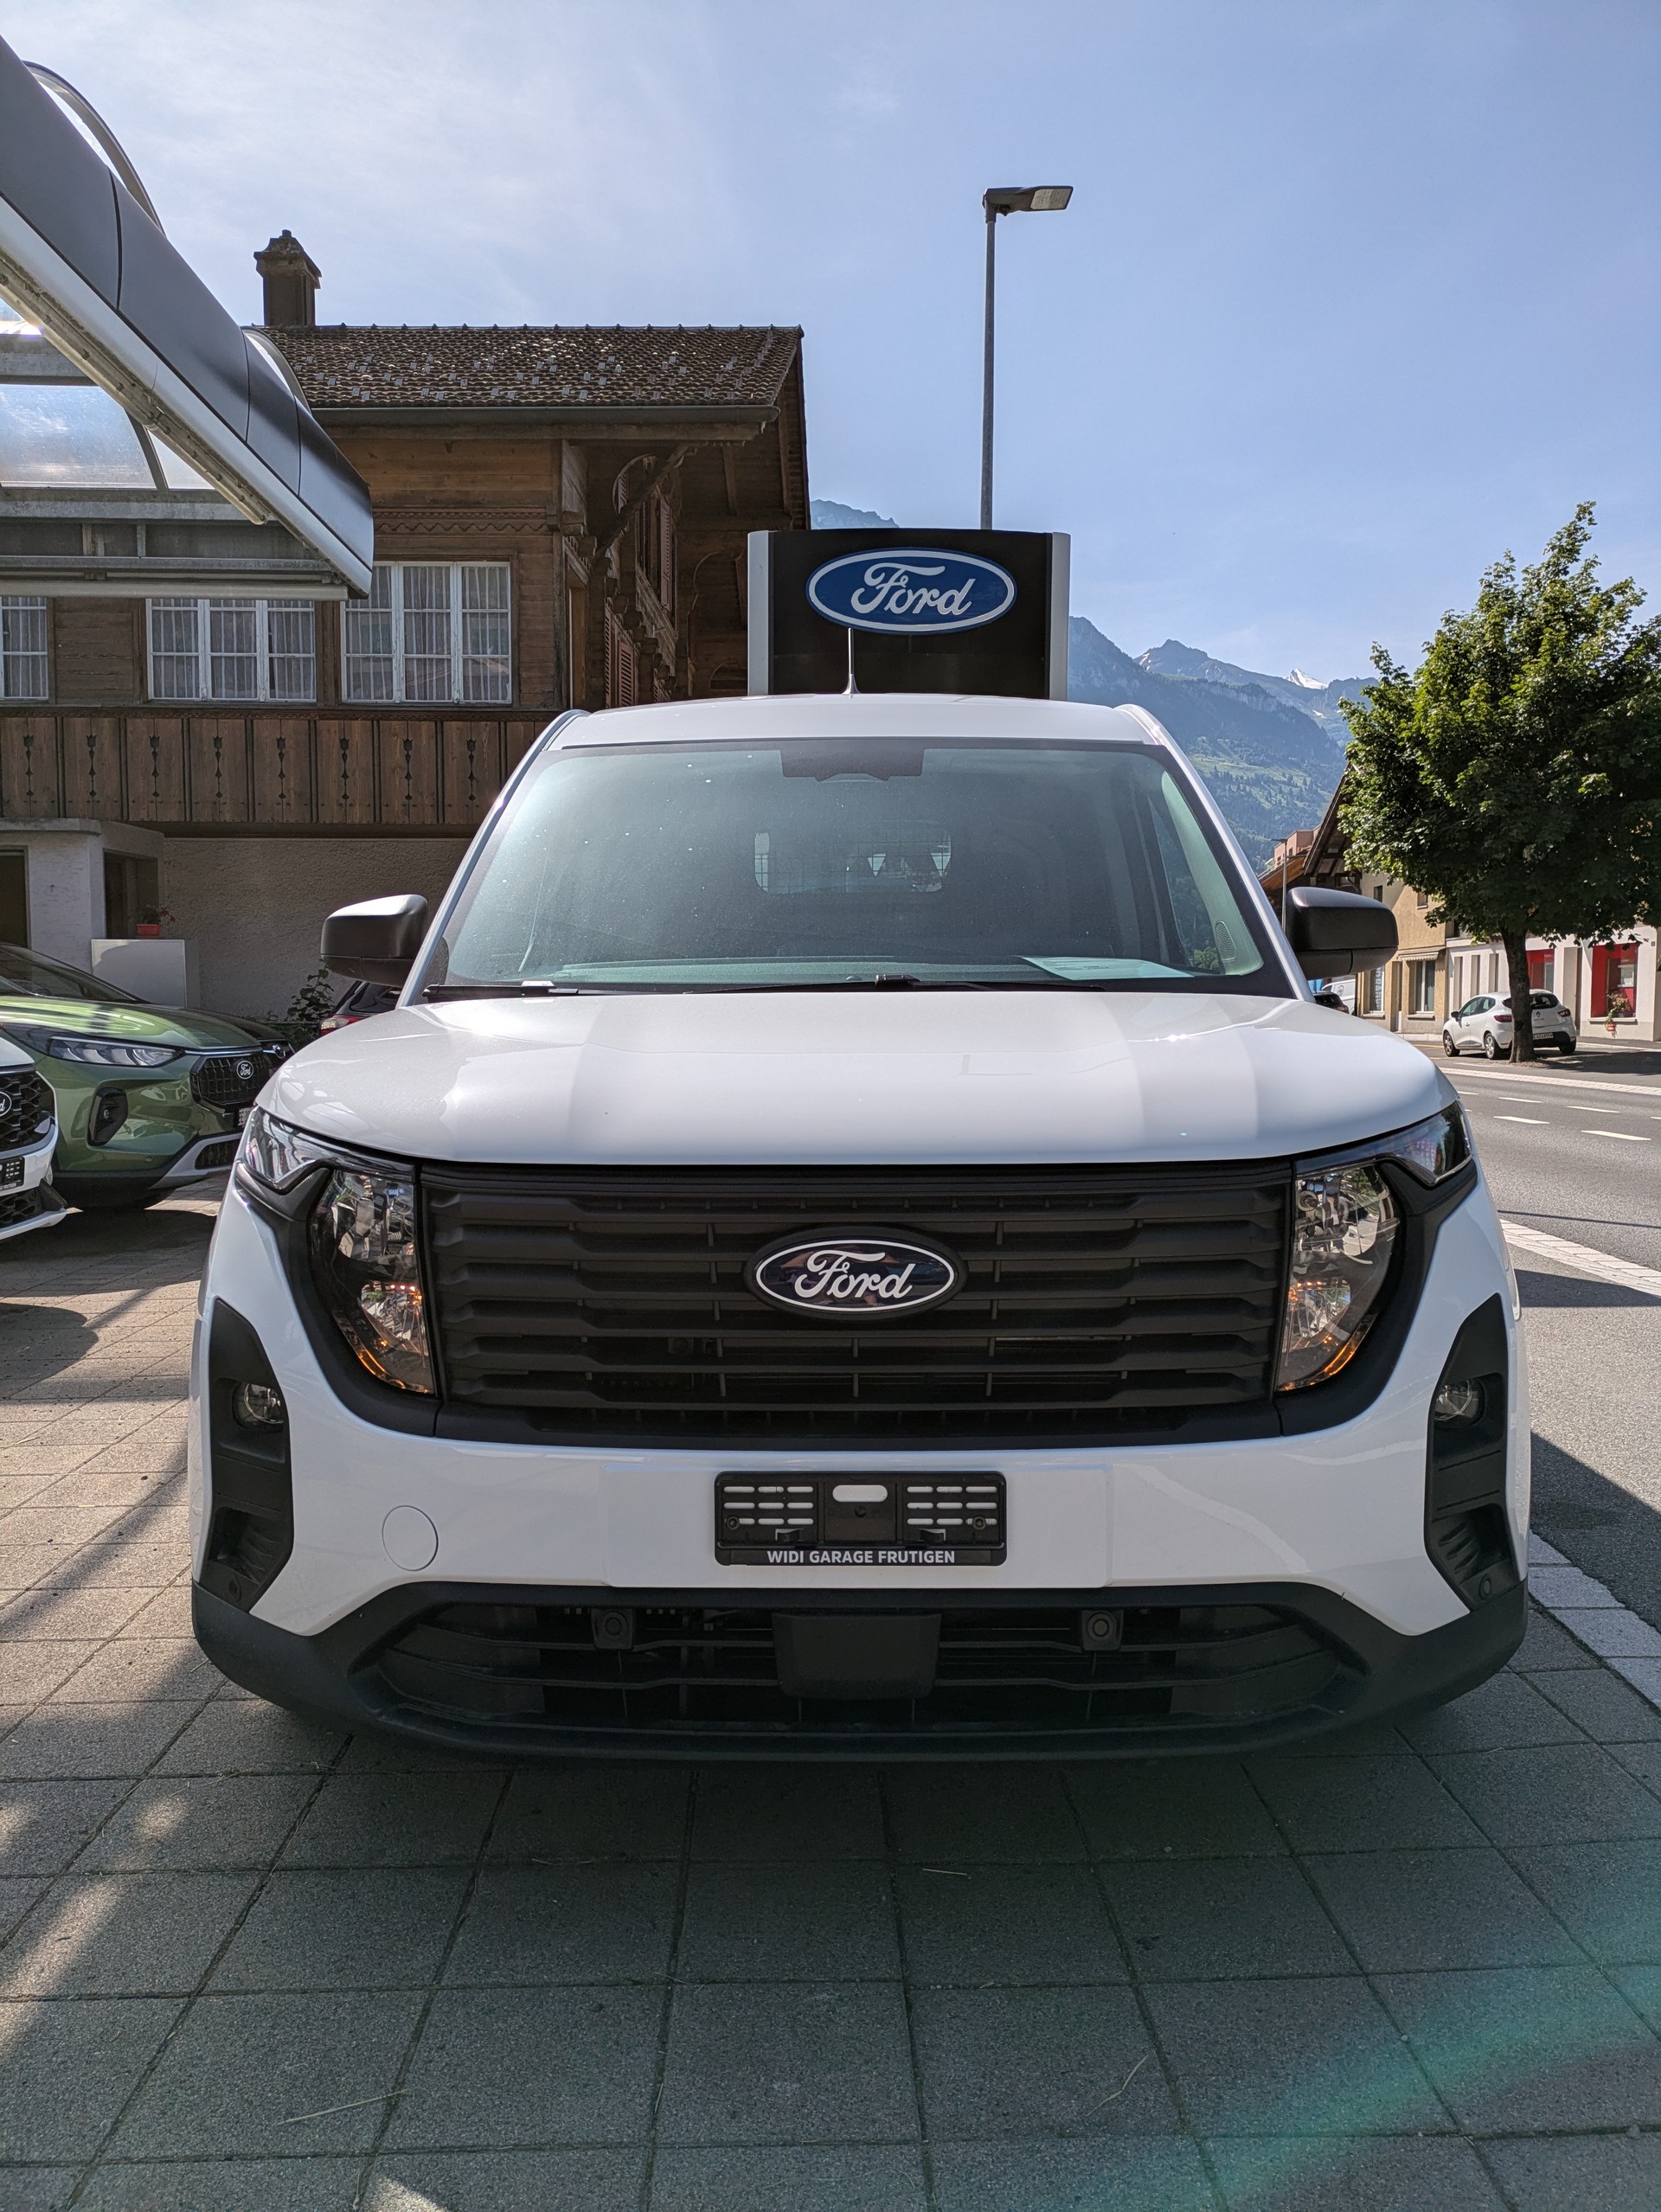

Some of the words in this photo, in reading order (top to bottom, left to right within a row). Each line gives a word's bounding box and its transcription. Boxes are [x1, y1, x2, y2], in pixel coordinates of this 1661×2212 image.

[850, 562, 976, 615] Ford
[794, 1249, 915, 1298] Ford
[766, 1550, 805, 1563] WIDI
[809, 1550, 874, 1563] GARAGE
[878, 1550, 955, 1563] FRUTIGEN
